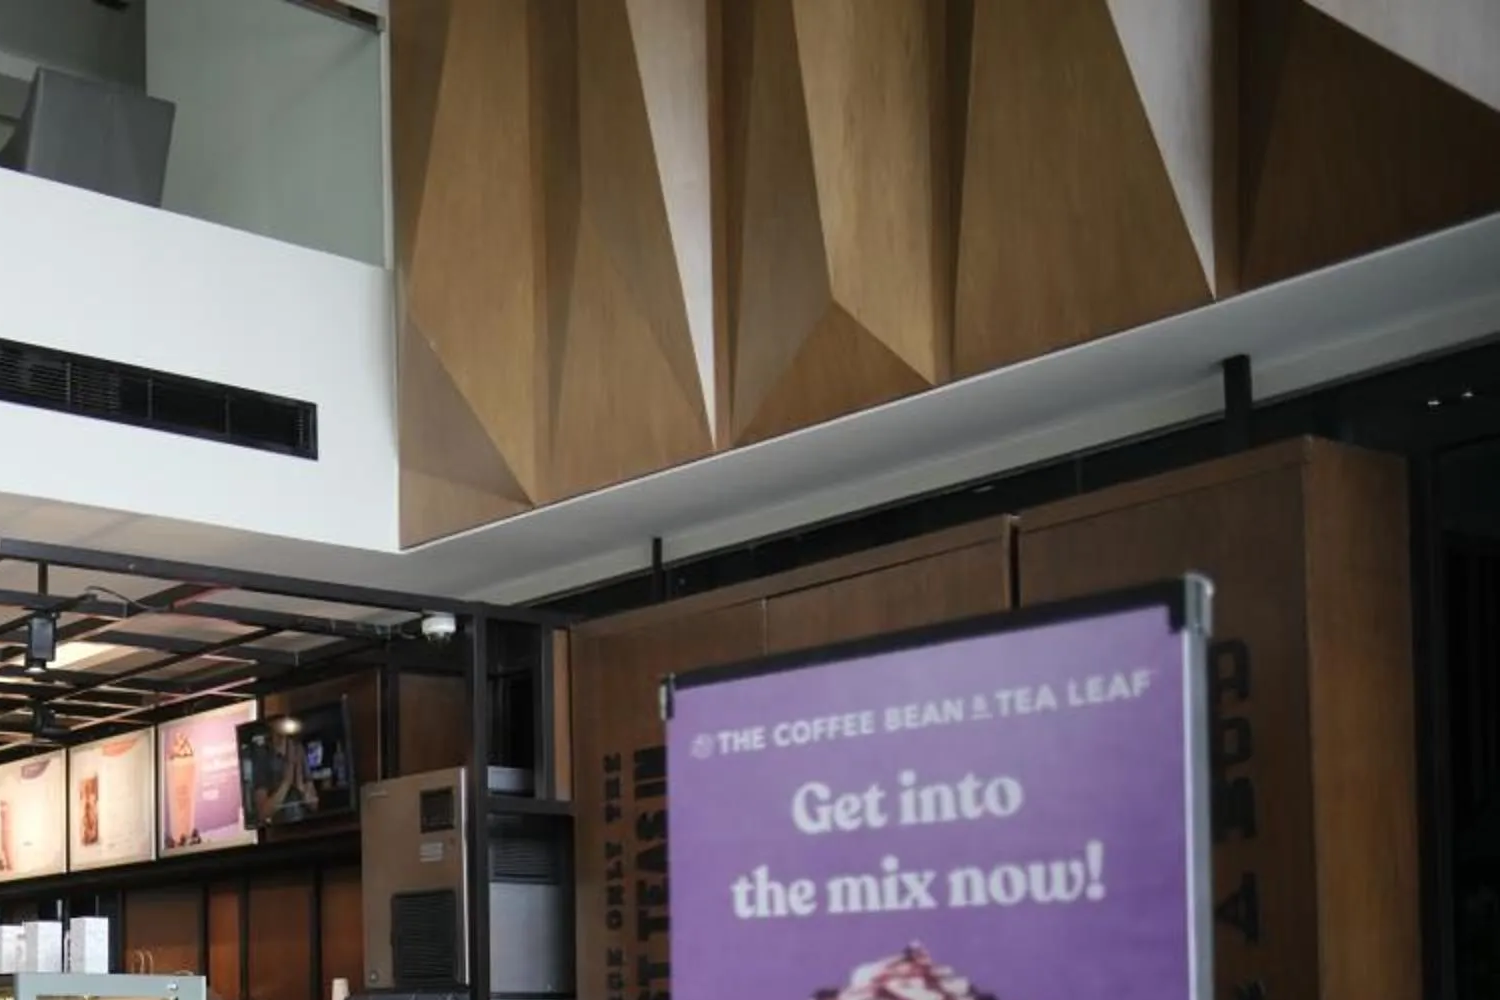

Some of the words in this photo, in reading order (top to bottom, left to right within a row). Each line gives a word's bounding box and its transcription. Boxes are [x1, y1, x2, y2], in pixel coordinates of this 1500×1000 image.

[717, 726, 766, 754] THE
[773, 710, 875, 747] COFFEE
[884, 698, 965, 731] BEAN
[995, 685, 1058, 717] TEA
[1068, 669, 1151, 706] LEAF
[792, 780, 889, 835] Get
[899, 769, 1024, 827] into
[731, 864, 817, 920] the
[827, 854, 937, 914] mix
[948, 840, 1106, 908] now!
